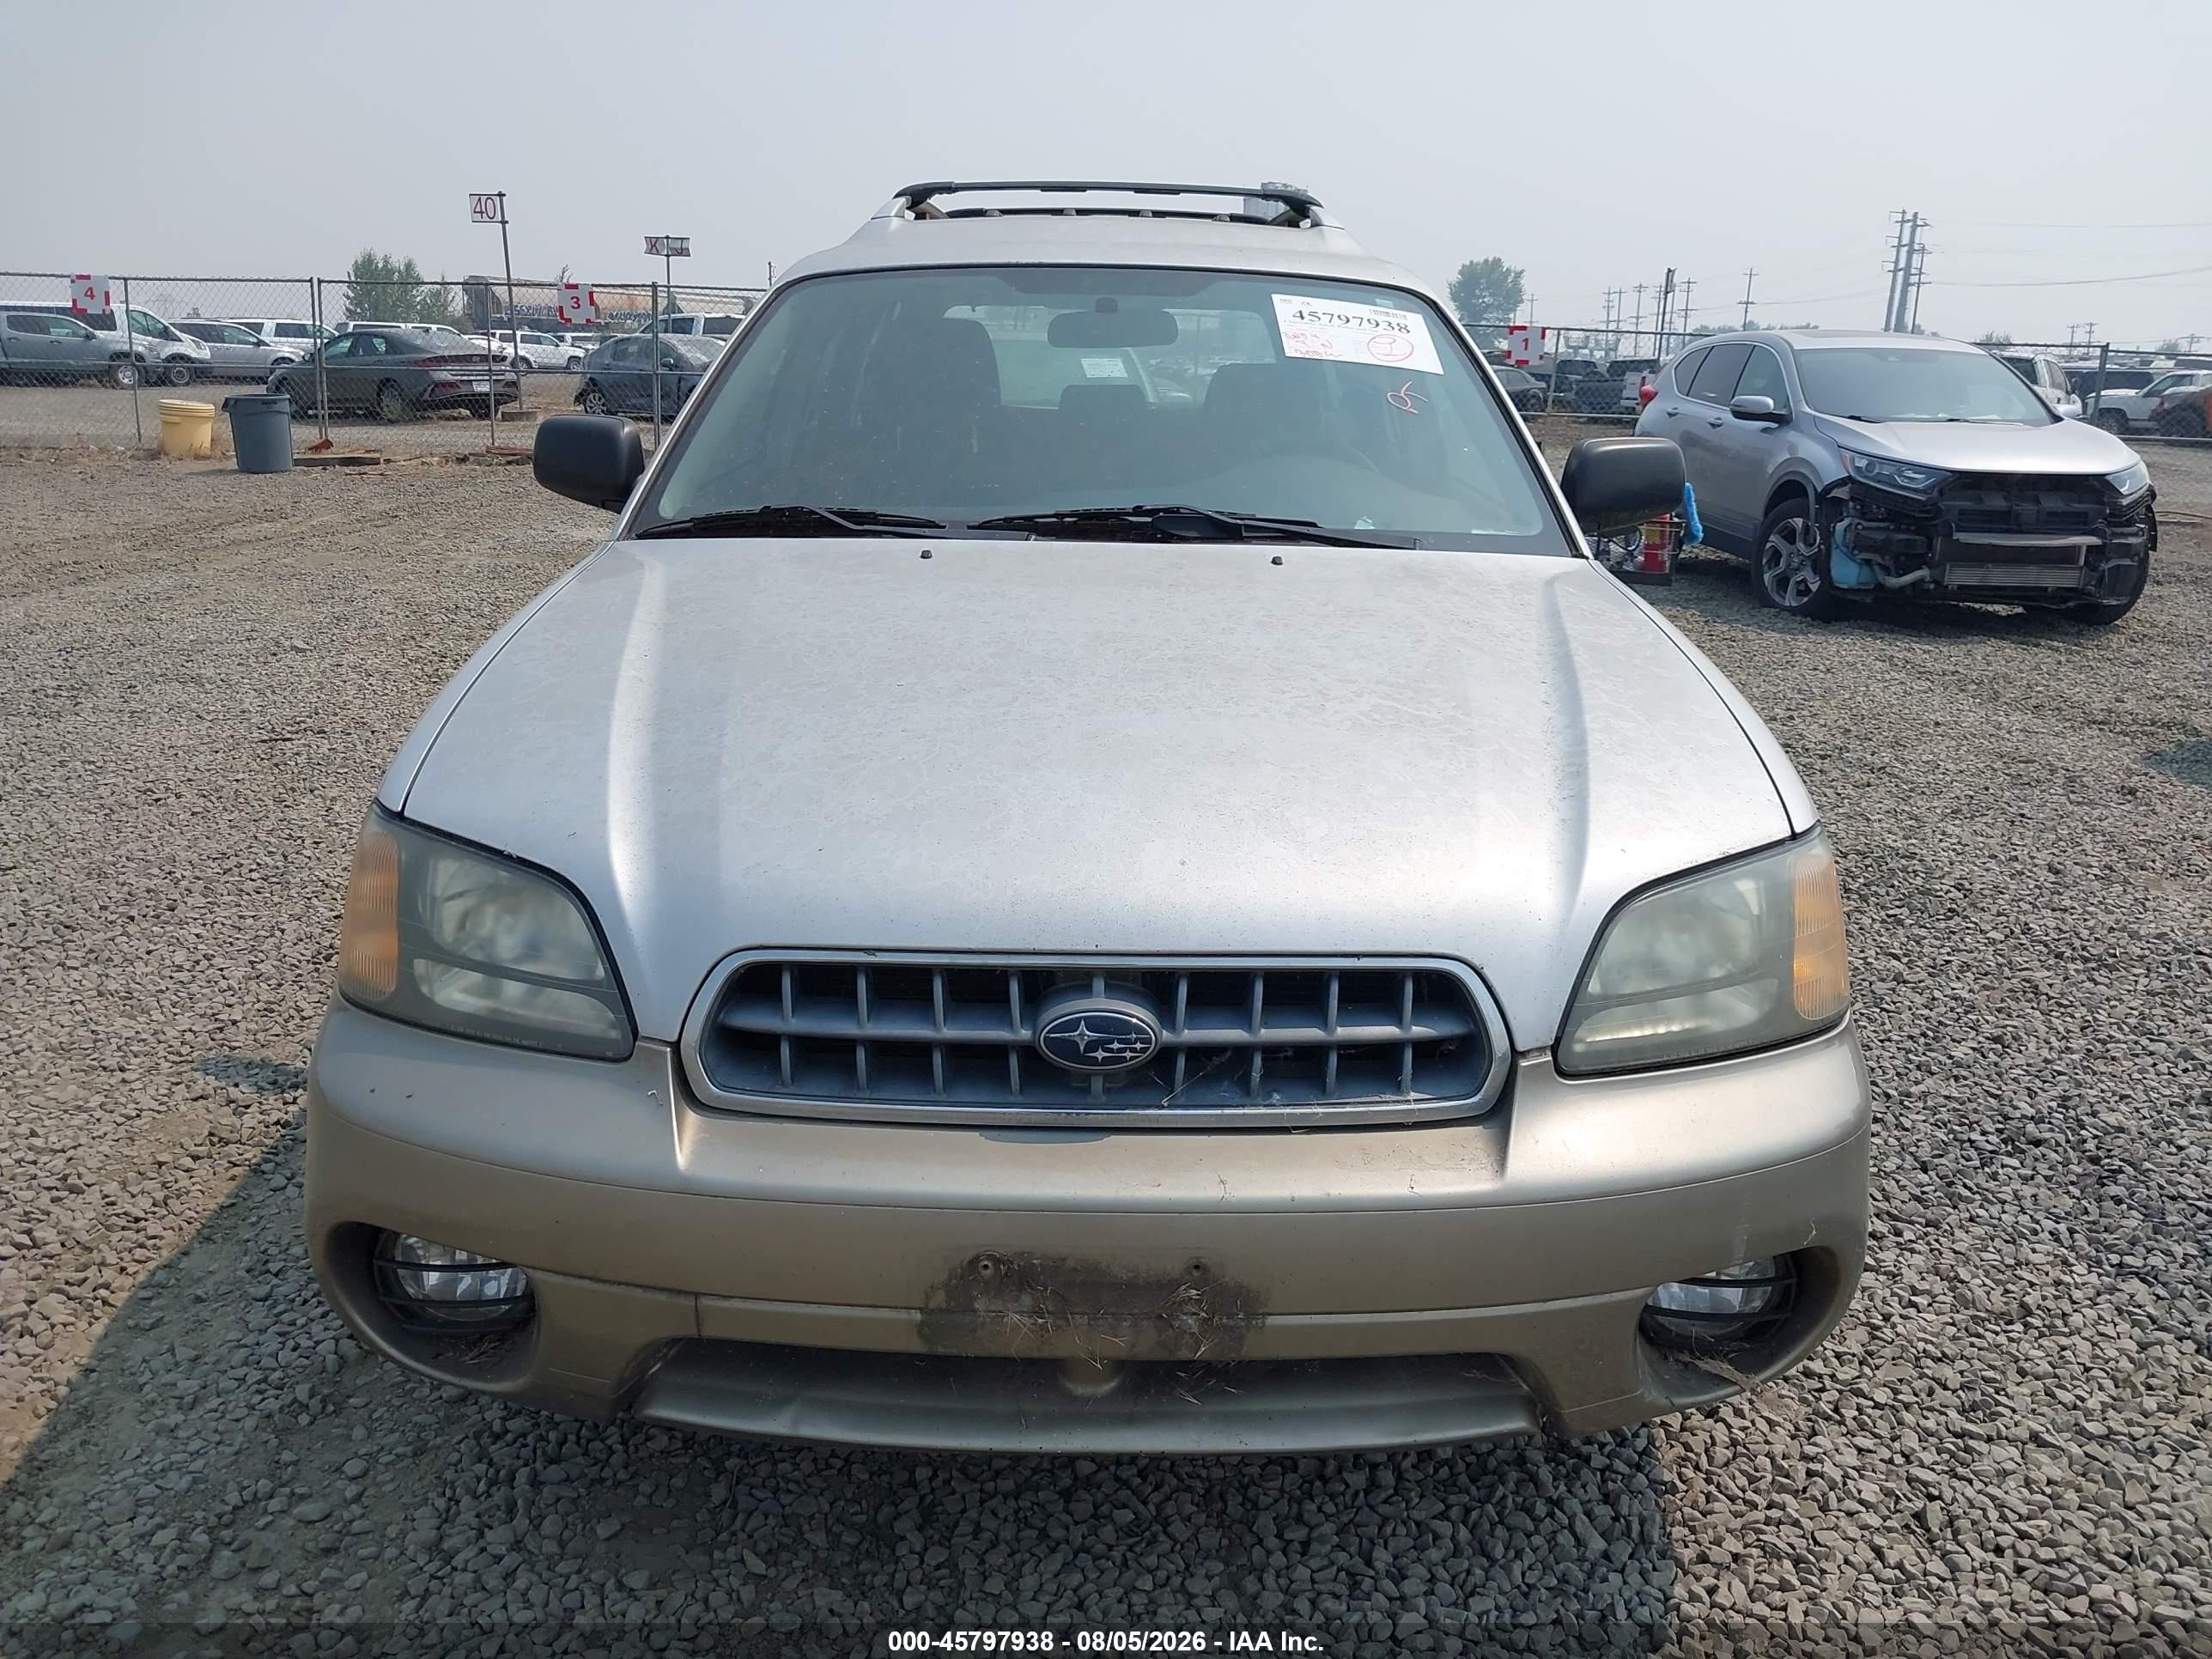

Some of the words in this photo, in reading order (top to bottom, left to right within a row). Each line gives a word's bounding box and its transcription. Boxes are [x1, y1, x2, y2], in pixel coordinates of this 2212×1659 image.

[473, 197, 496, 220] 40
[649, 238, 659, 253] K
[675, 240, 684, 255] J
[84, 287, 95, 300] 4
[570, 295, 581, 309] 3
[1291, 309, 1411, 334] 45797938
[1522, 337, 1529, 351] 1
